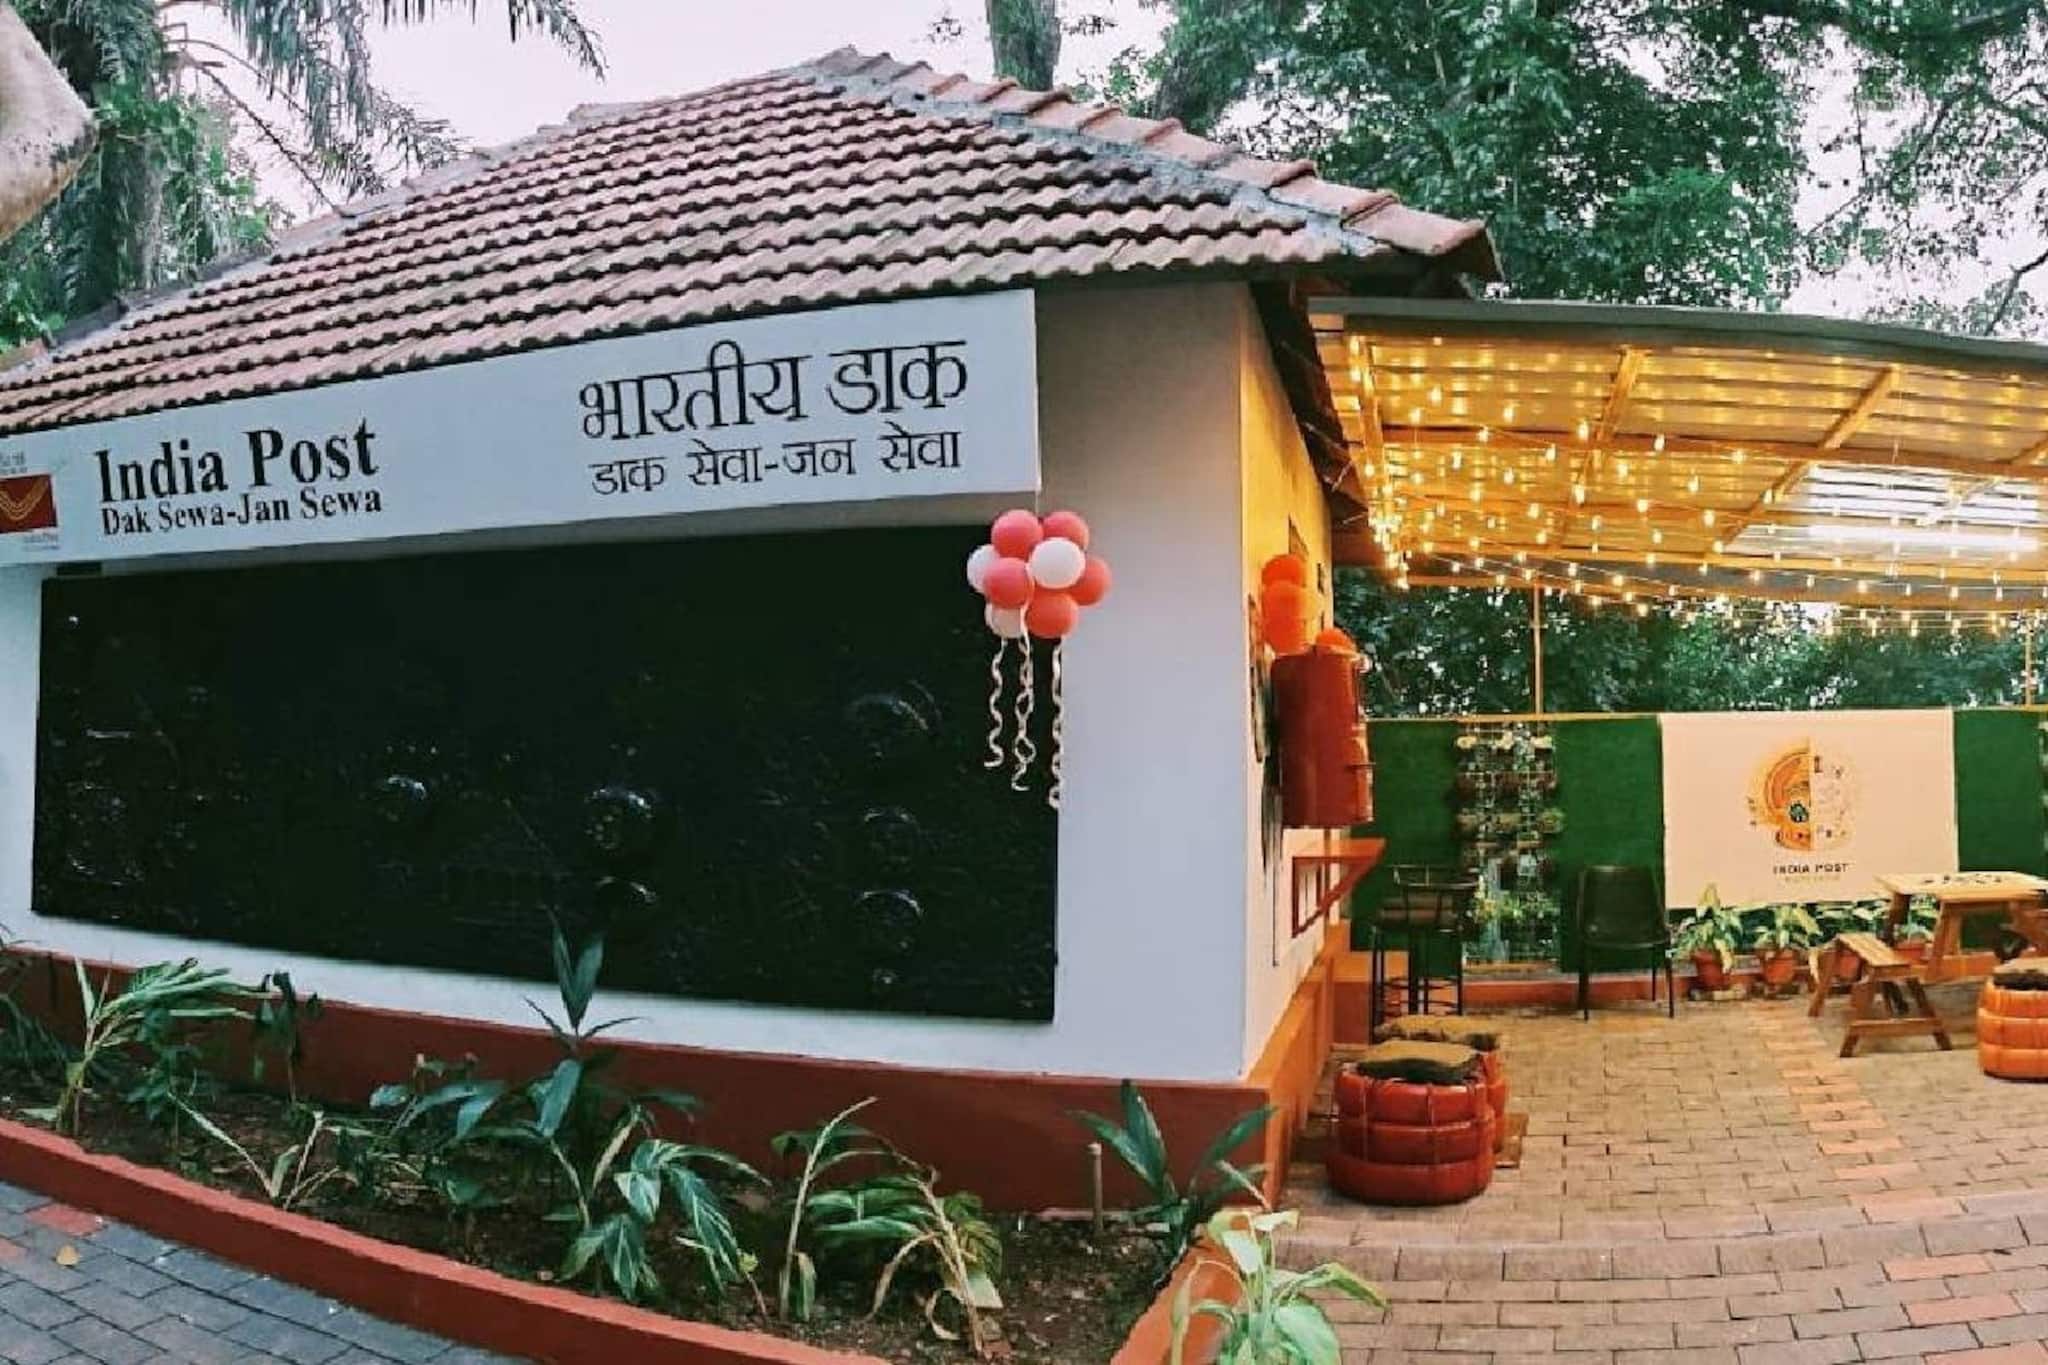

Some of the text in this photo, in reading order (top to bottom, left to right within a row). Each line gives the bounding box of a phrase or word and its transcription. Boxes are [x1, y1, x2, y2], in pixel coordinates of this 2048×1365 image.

[579, 340, 969, 440] भारतीय डाक
[94, 417, 381, 503] India Post
[588, 421, 962, 495] डाक सेवा-जन सेवा
[102, 489, 382, 536] Dak Sewa-Jan Sewa
